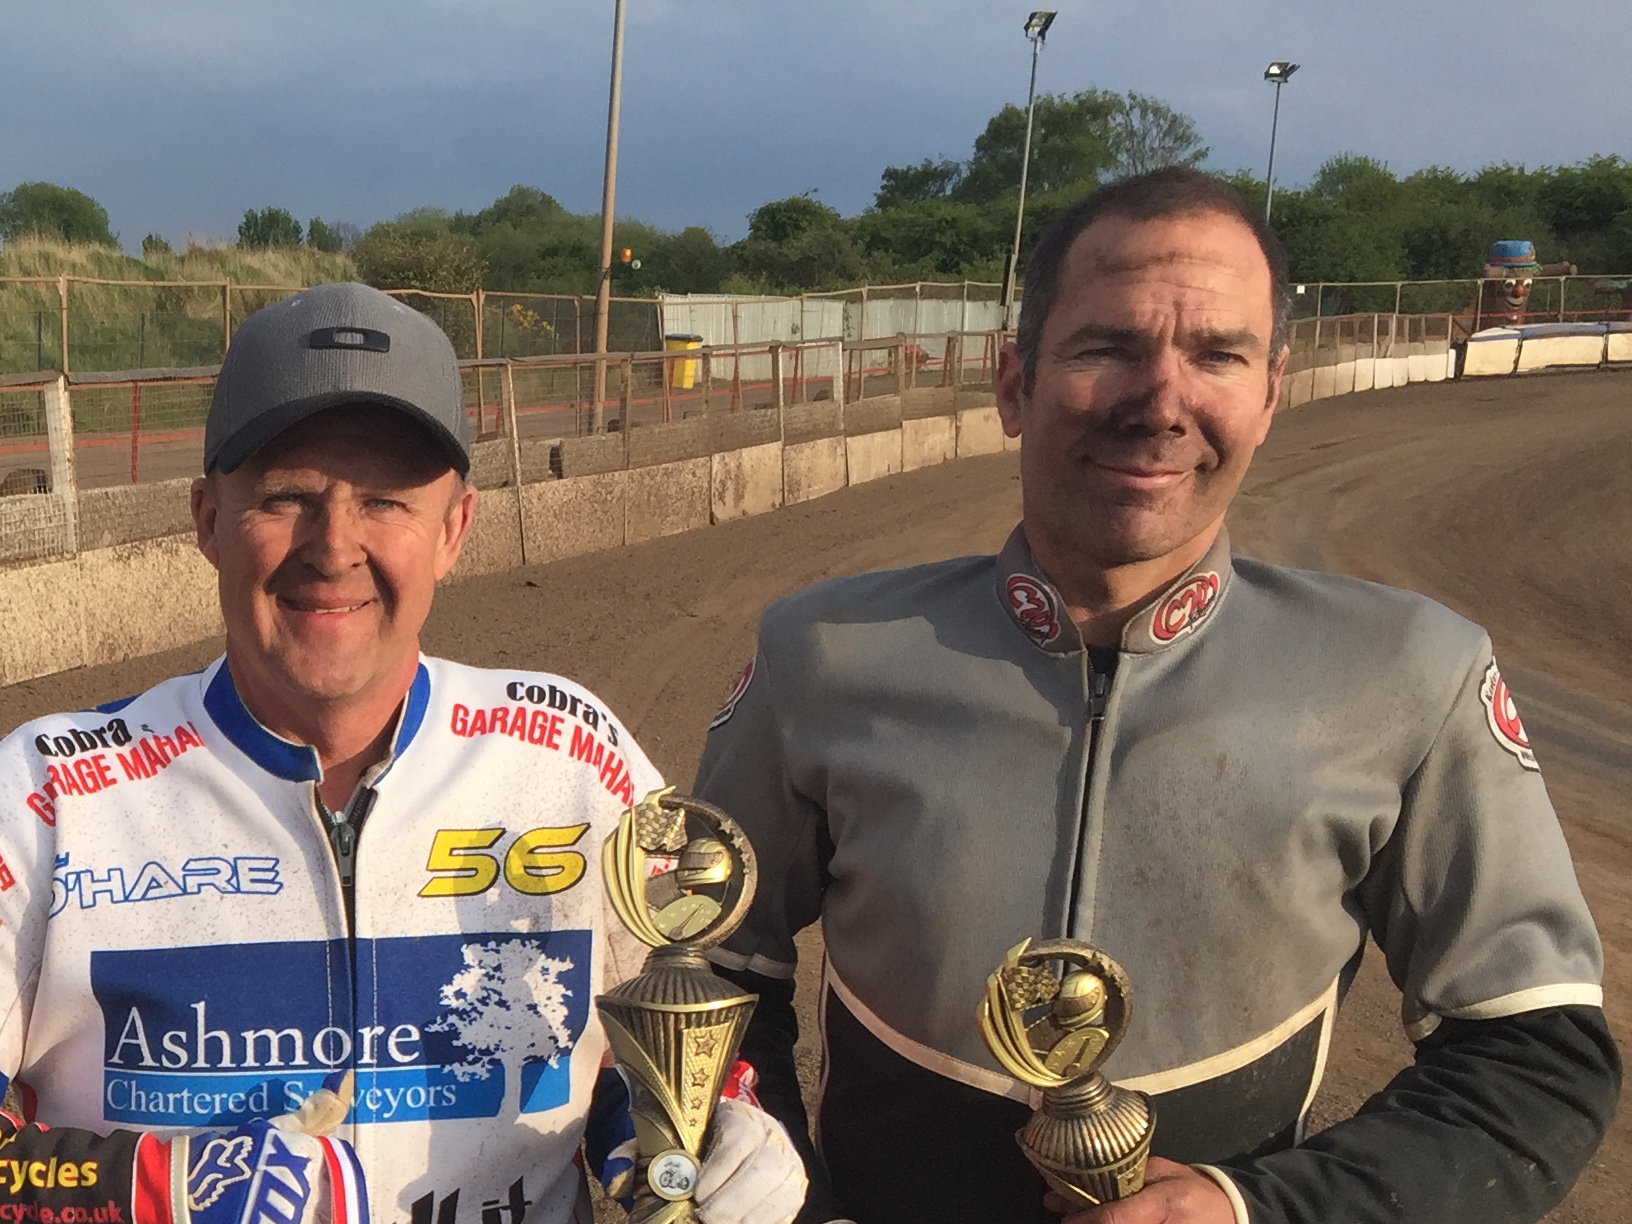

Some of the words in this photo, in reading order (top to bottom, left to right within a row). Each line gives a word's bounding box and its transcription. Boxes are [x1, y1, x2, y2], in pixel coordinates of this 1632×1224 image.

[450, 703, 565, 751] GARAGE
[417, 822, 591, 897] 56
[107, 1000, 421, 1068] Ashmore
[106, 1078, 269, 1116] Chartered
[282, 1079, 457, 1119] Sveyors
